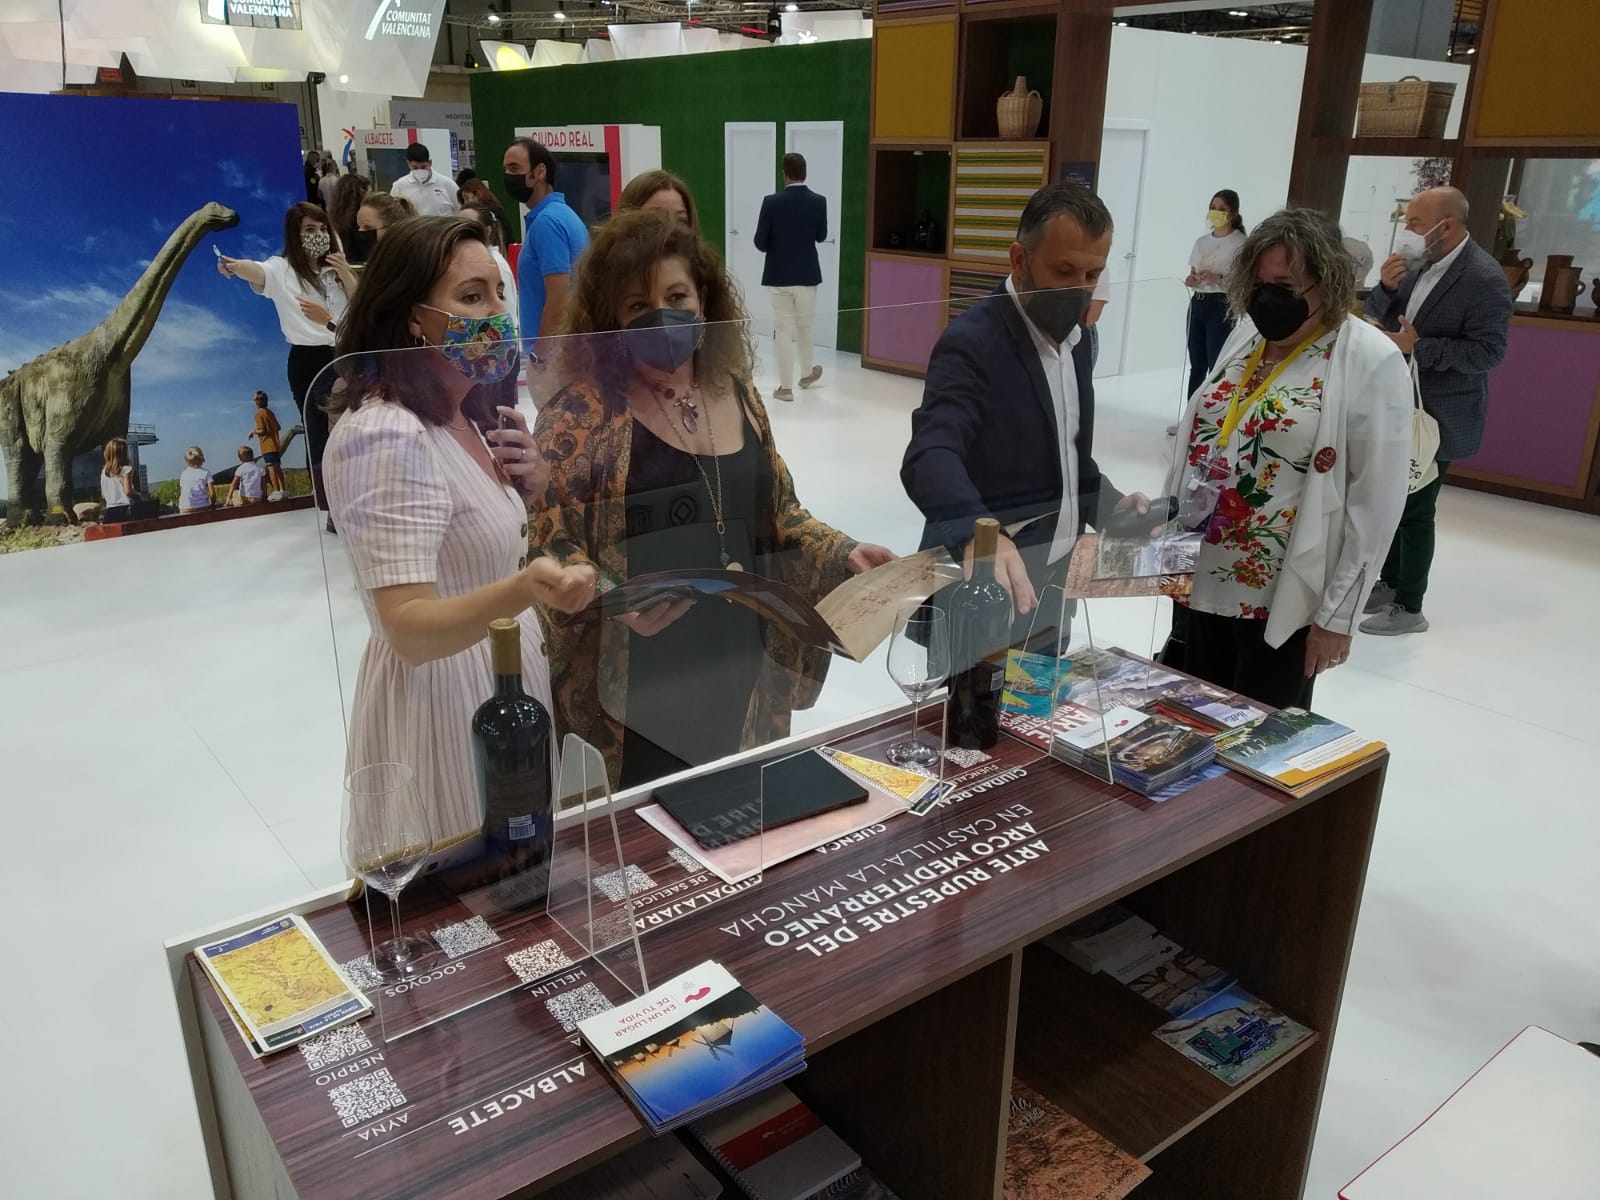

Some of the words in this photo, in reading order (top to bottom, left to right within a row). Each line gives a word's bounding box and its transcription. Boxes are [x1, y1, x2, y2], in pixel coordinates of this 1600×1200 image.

[230, 4, 293, 18] VALENCIANA
[386, 9, 432, 25] COMUNITAT
[381, 22, 431, 39] VALENCIANA
[364, 132, 394, 145] ALBACETE
[531, 131, 566, 147] CIUDAD
[570, 131, 594, 147] REAL
[953, 763, 999, 786] FUENCALI
[972, 768, 1028, 794] CIUDAD
[997, 803, 1034, 824] EN
[815, 822, 887, 855] CUENCA
[847, 818, 997, 883] CASTILLA-LA
[971, 821, 1038, 855] ARCO
[987, 839, 1050, 874] ARTE
[689, 876, 708, 886] DE
[625, 882, 689, 910] SAELICES
[718, 878, 848, 938] MANCHA
[764, 851, 973, 947] MEDITERRÁNEO
[857, 869, 992, 933] RUPESTRE
[796, 922, 860, 957] DEL
[384, 961, 466, 998] SOCOVOS
[531, 969, 587, 999] HELLÍN
[642, 1005, 657, 1014] TU
[656, 996, 670, 1007] DE
[663, 1003, 677, 1014] EN
[614, 1018, 648, 1037] LUGAR
[619, 1013, 641, 1024] VIDA
[648, 1011, 663, 1022] UN
[315, 1052, 385, 1086] NERPIO
[447, 1061, 586, 1135] ALBACETE
[357, 1112, 409, 1141] AYNA
